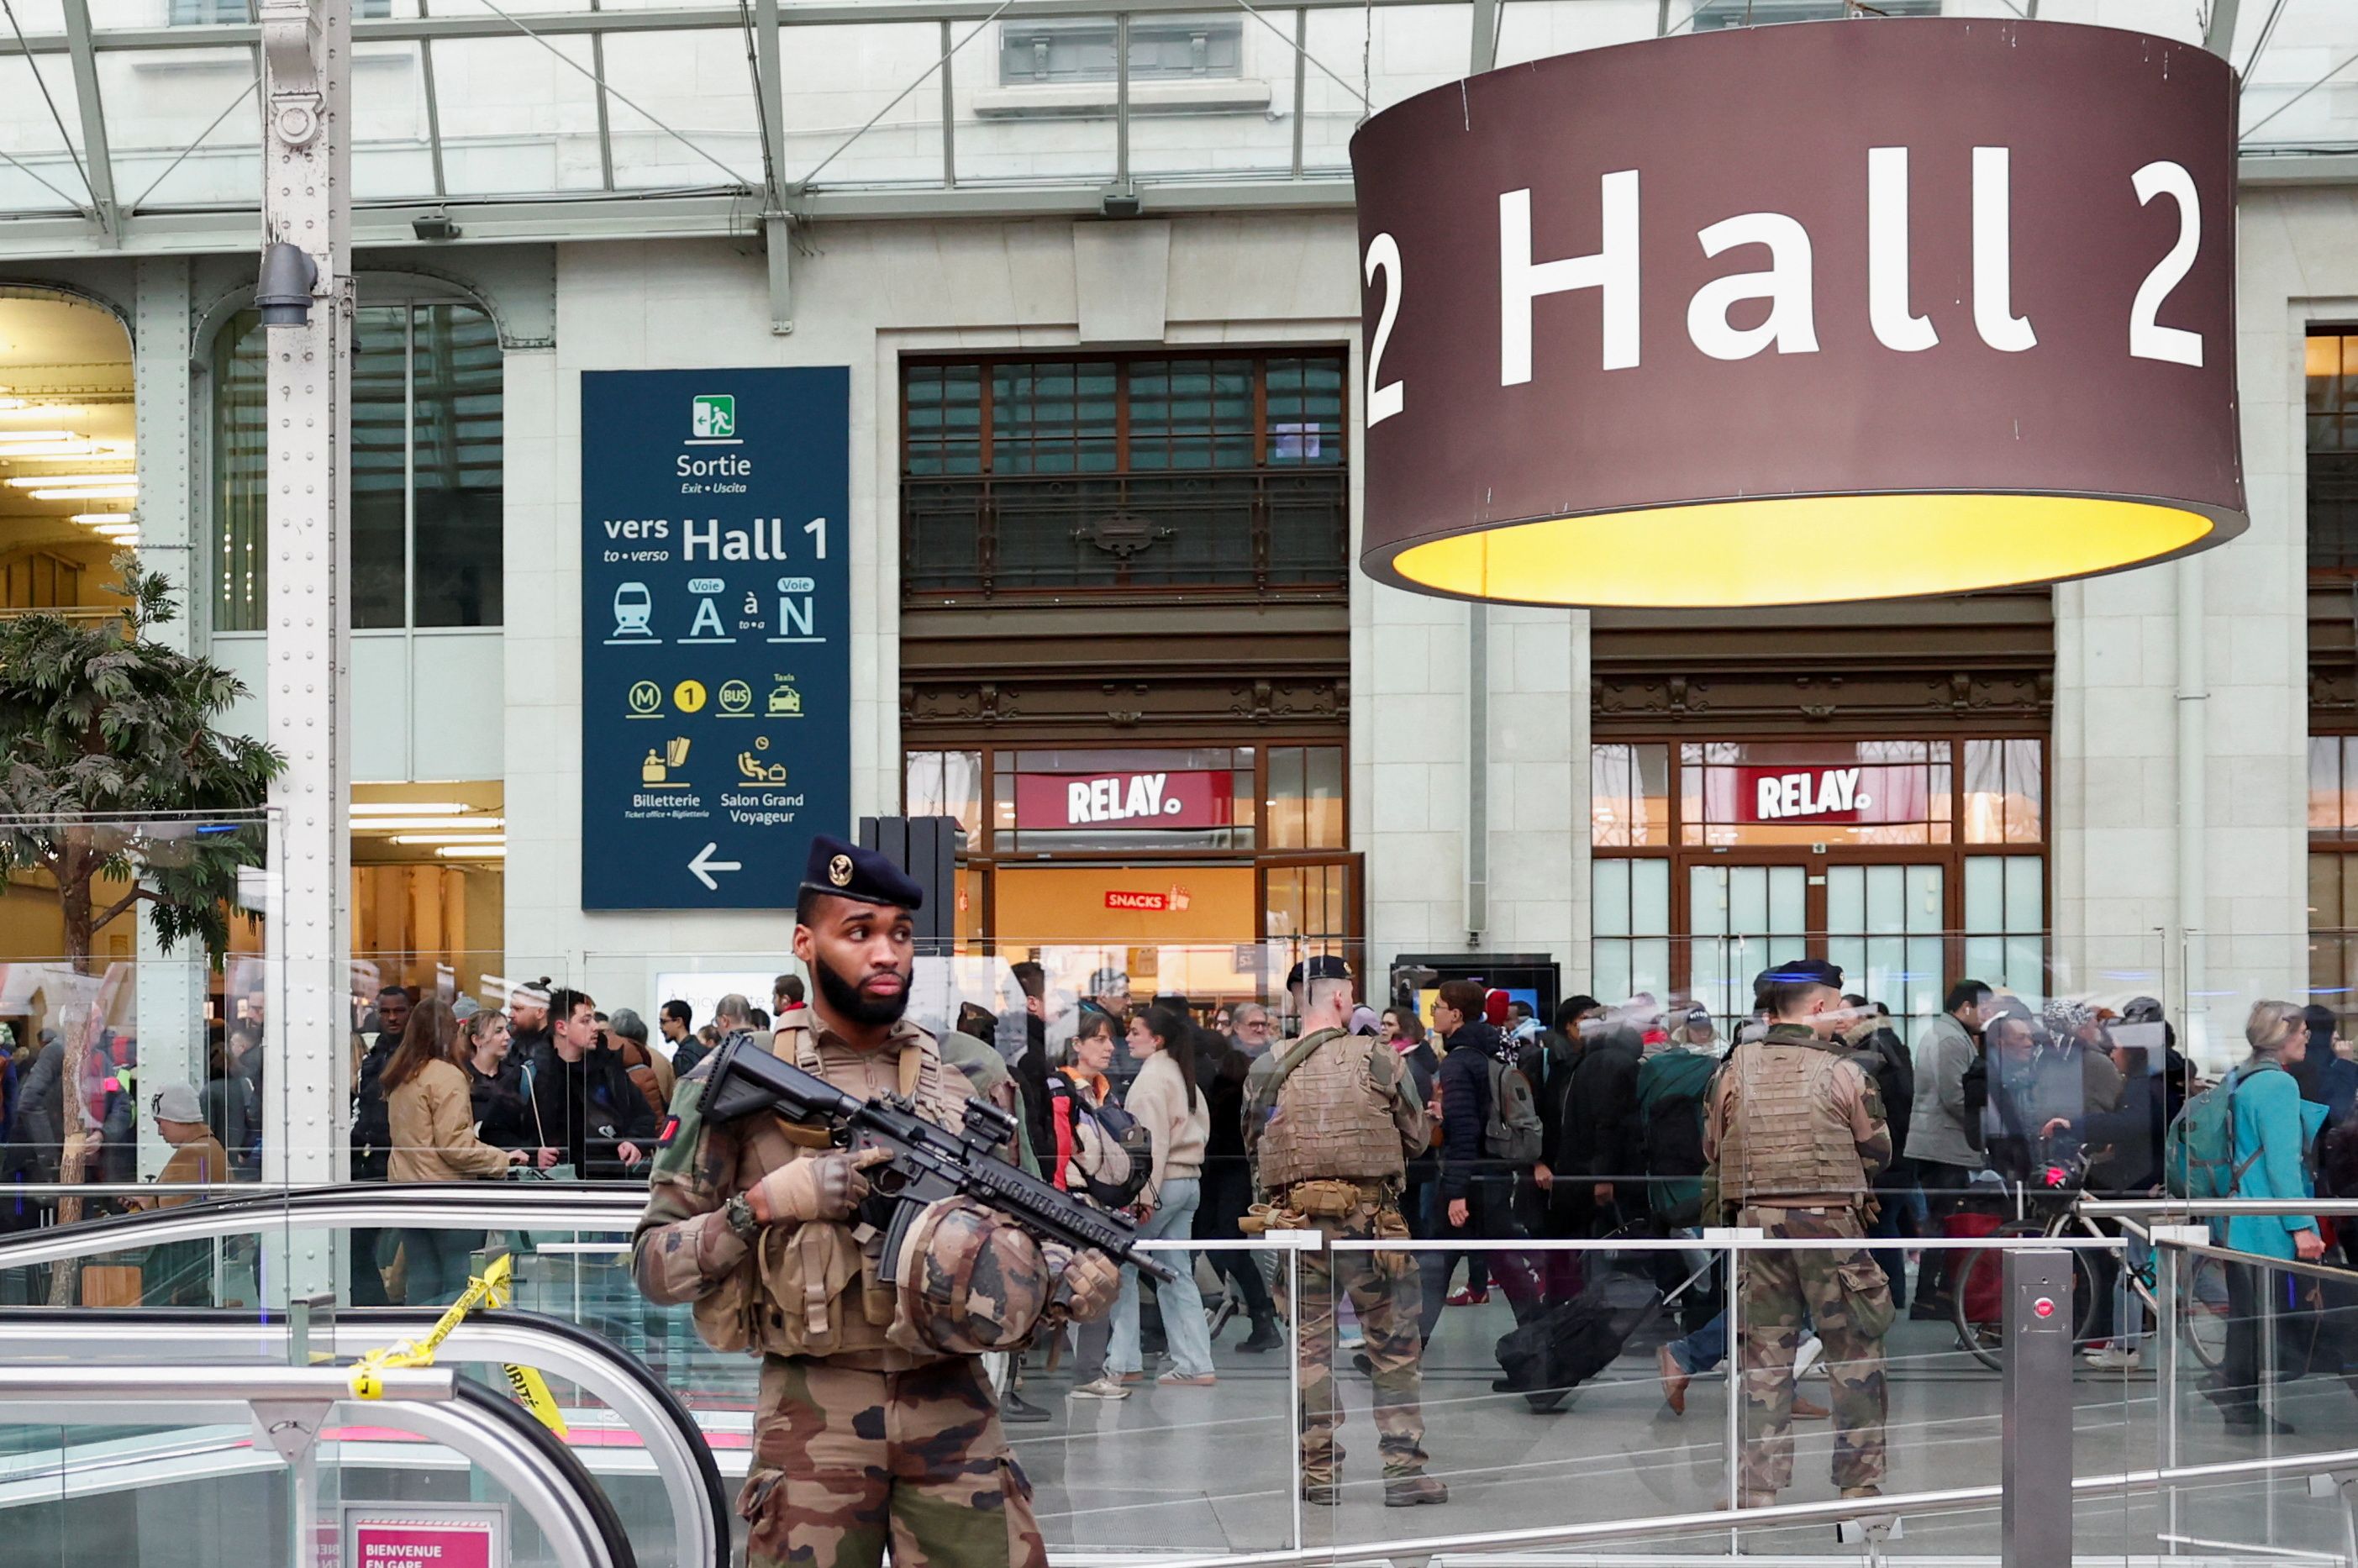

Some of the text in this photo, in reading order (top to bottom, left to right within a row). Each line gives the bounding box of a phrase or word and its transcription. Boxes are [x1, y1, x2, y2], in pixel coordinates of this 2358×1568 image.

[1364, 146, 2203, 429] 2 Hall 2
[676, 454, 751, 476] Sortie
[682, 482, 747, 493] Exit Uscita
[603, 518, 827, 561] vers Hall 1
[603, 550, 669, 562] to verso
[692, 581, 719, 591] Voie
[782, 579, 809, 590] Voie
[689, 592, 813, 636] A à N
[739, 620, 765, 629] to a
[774, 673, 795, 681] Taxis
[635, 687, 747, 706] M 1 BUS
[633, 793, 701, 808] Billetterie
[720, 792, 804, 807] Salon Grand
[625, 810, 645, 818] Ticket
[645, 810, 666, 818] office
[729, 809, 795, 825] Voyageur
[1108, 893, 1163, 908] SNACKS
[366, 1544, 442, 1557] BIENVENUE
[366, 1560, 383, 1568] EN
